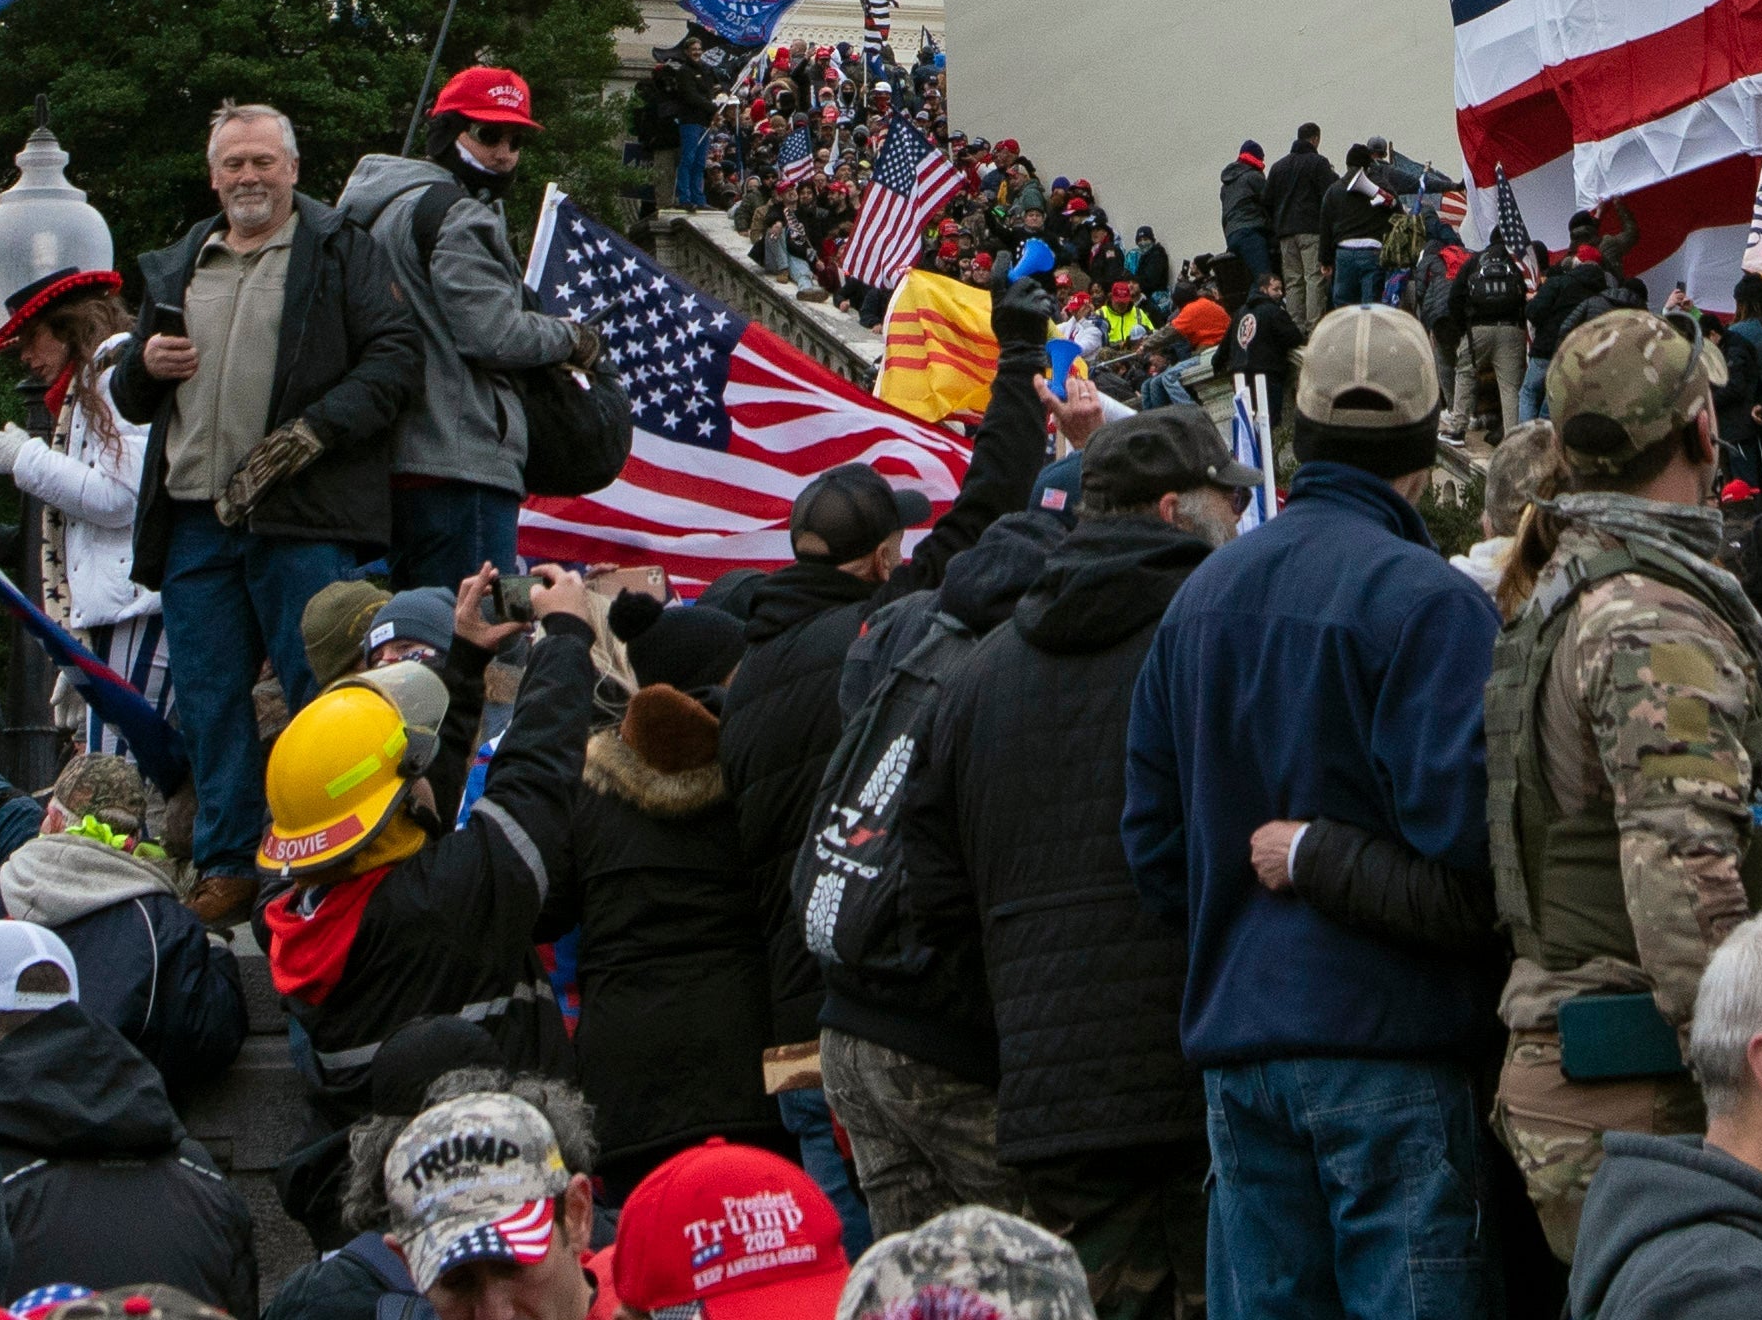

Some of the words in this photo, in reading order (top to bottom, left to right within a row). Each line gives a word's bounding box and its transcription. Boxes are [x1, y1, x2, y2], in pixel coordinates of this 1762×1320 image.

[276, 830, 330, 860] SOVIE
[402, 1135, 521, 1191] TRUMP
[722, 1190, 797, 1215] President
[683, 1204, 804, 1252] Trump
